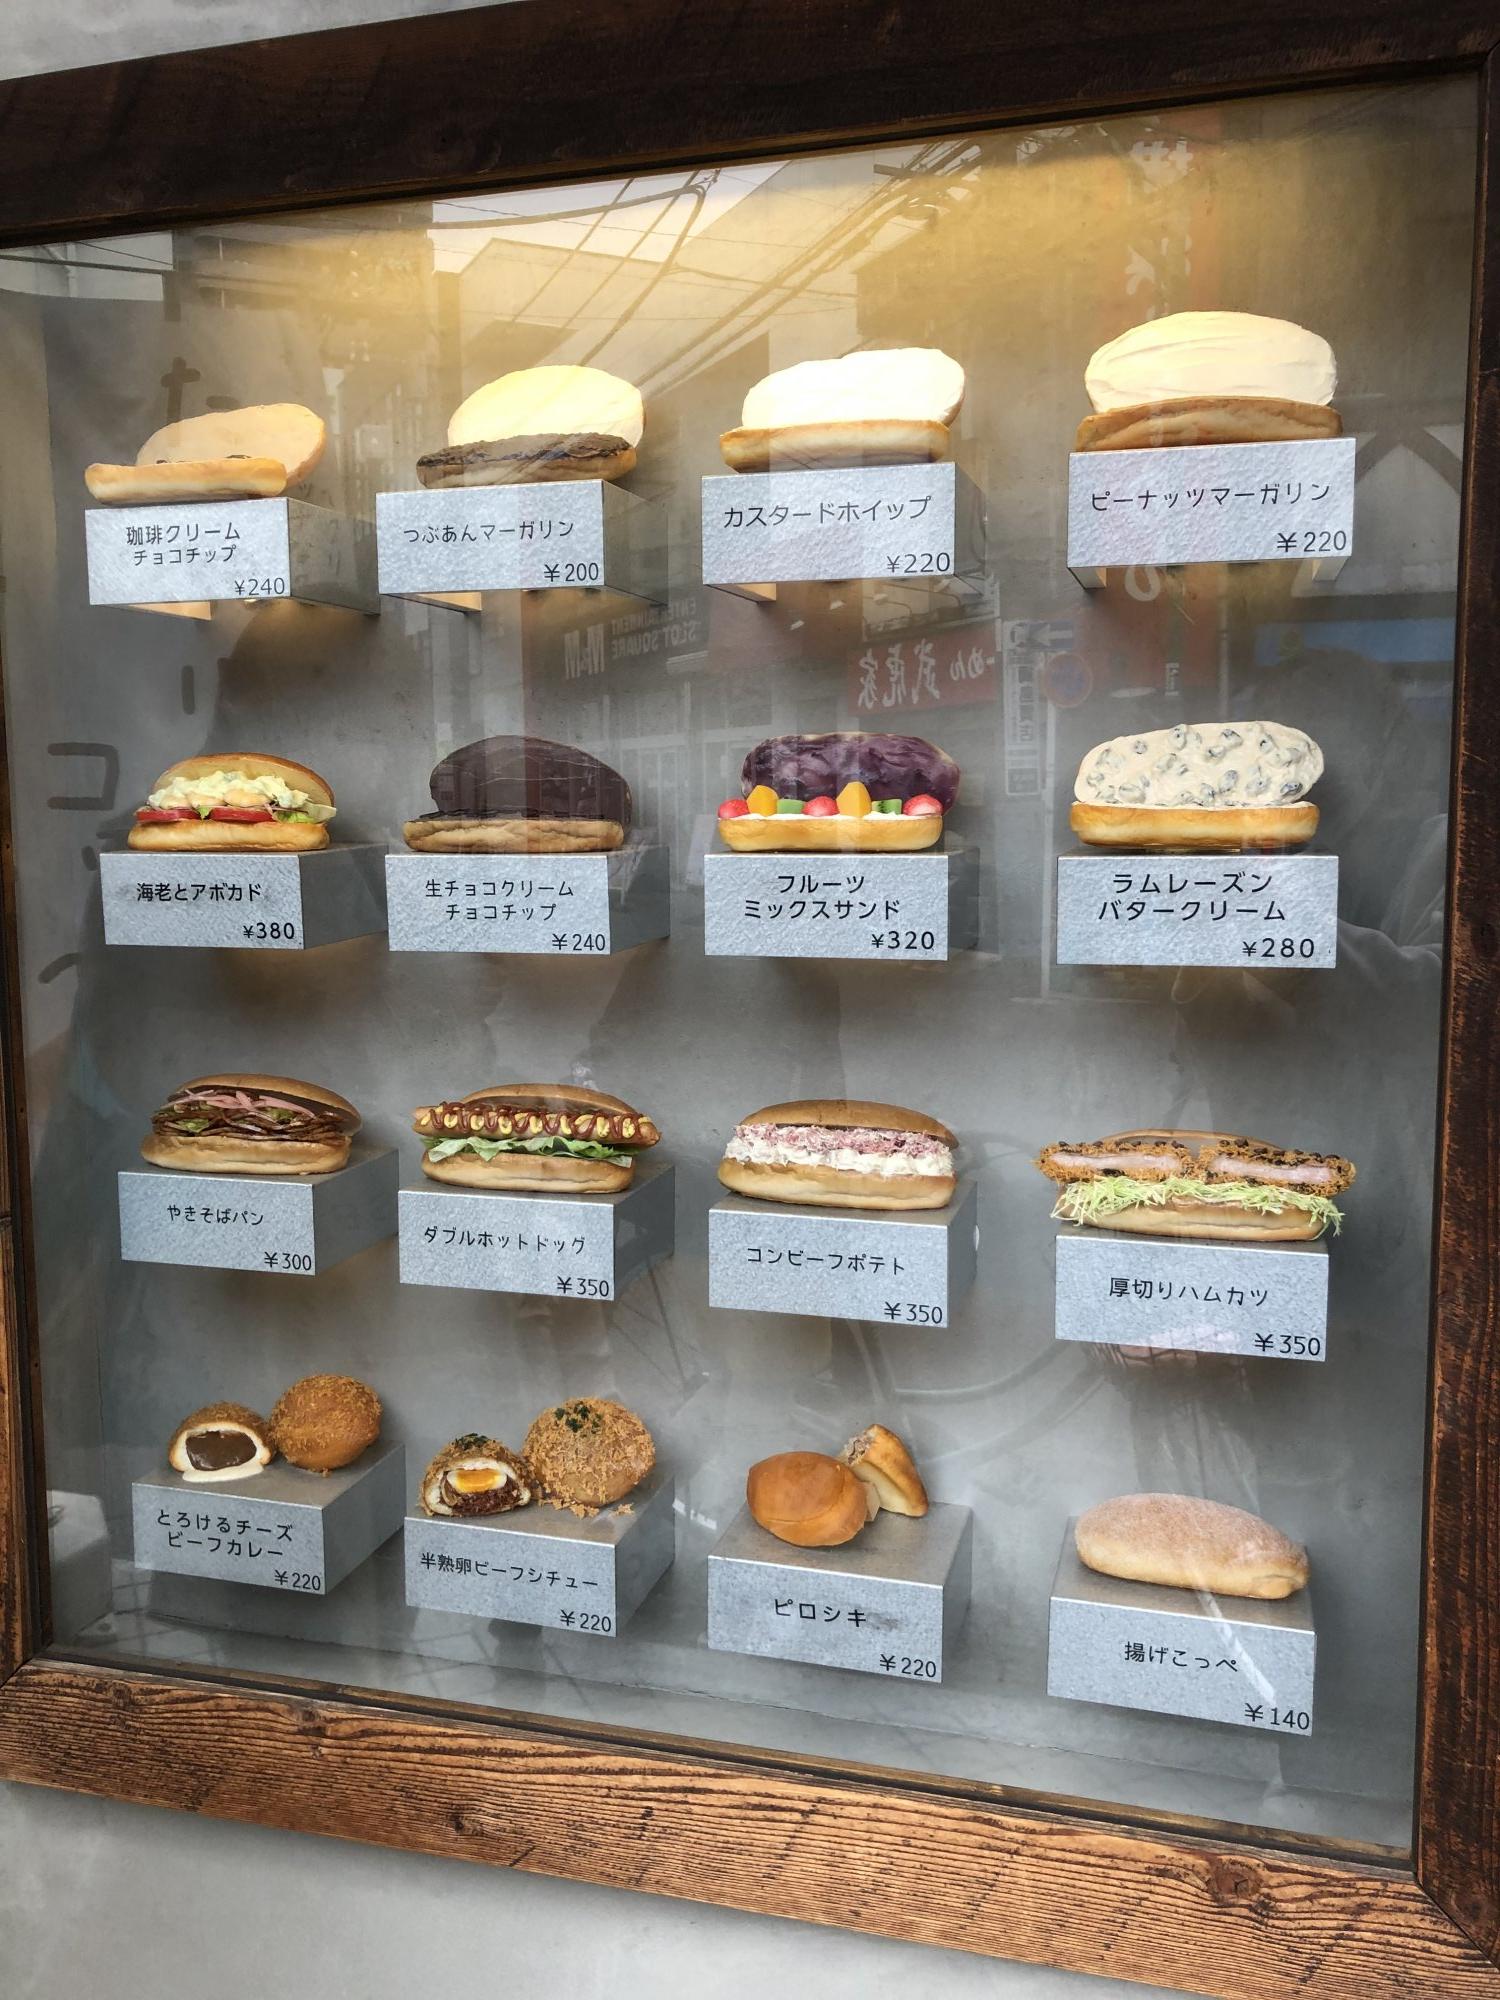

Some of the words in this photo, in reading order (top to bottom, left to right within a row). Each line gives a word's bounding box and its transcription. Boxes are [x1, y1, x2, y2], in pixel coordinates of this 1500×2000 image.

[1091, 482, 1330, 512] ピーナッツマーガリン
[723, 495, 932, 529] カスタードホイップ
[125, 521, 241, 545] 珈琲クリーム
[403, 519, 574, 544] つぶあんマーガリン
[1276, 530, 1347, 553] ¥220
[133, 544, 237, 567] チョコチップ
[887, 552, 951, 574] ¥220
[543, 562, 599, 583] ¥200
[234, 577, 286, 596] ¥240
[136, 882, 261, 902] 海老とアボカド
[425, 878, 574, 898] 生チョコクリーム
[777, 874, 865, 894] フルーツ
[1113, 871, 1272, 894] ラムレーズン
[445, 903, 557, 921] チョコチップ
[744, 899, 900, 921] ミックスサンド
[1098, 899, 1286, 921] バタークリーム
[242, 921, 295, 940] ¥380
[871, 930, 935, 950] ¥320
[551, 933, 606, 952] ¥240
[1242, 937, 1315, 959] ¥280
[166, 1204, 264, 1226] やきそばパン
[424, 1225, 585, 1255] ダブルホットドッグ
[263, 1251, 312, 1273] ¥300
[747, 1247, 905, 1276] コンビーフポテト
[556, 1275, 610, 1299] ¥350
[1109, 1277, 1268, 1307] 厚切りハムカツ
[883, 1301, 943, 1324] ¥350
[1253, 1332, 1321, 1357] ¥350
[157, 1509, 293, 1542] とろけるチーズ
[168, 1533, 283, 1558] ビーフカレー
[274, 1569, 321, 1592] ¥220
[420, 1551, 598, 1589] 半熟卵ビーフシチュー
[560, 1609, 612, 1634] ¥220
[774, 1598, 867, 1628] ピロシキ
[879, 1653, 937, 1679] ¥220
[1124, 1640, 1238, 1673] 揚げこっぺ
[1244, 1702, 1310, 1732] ¥140
